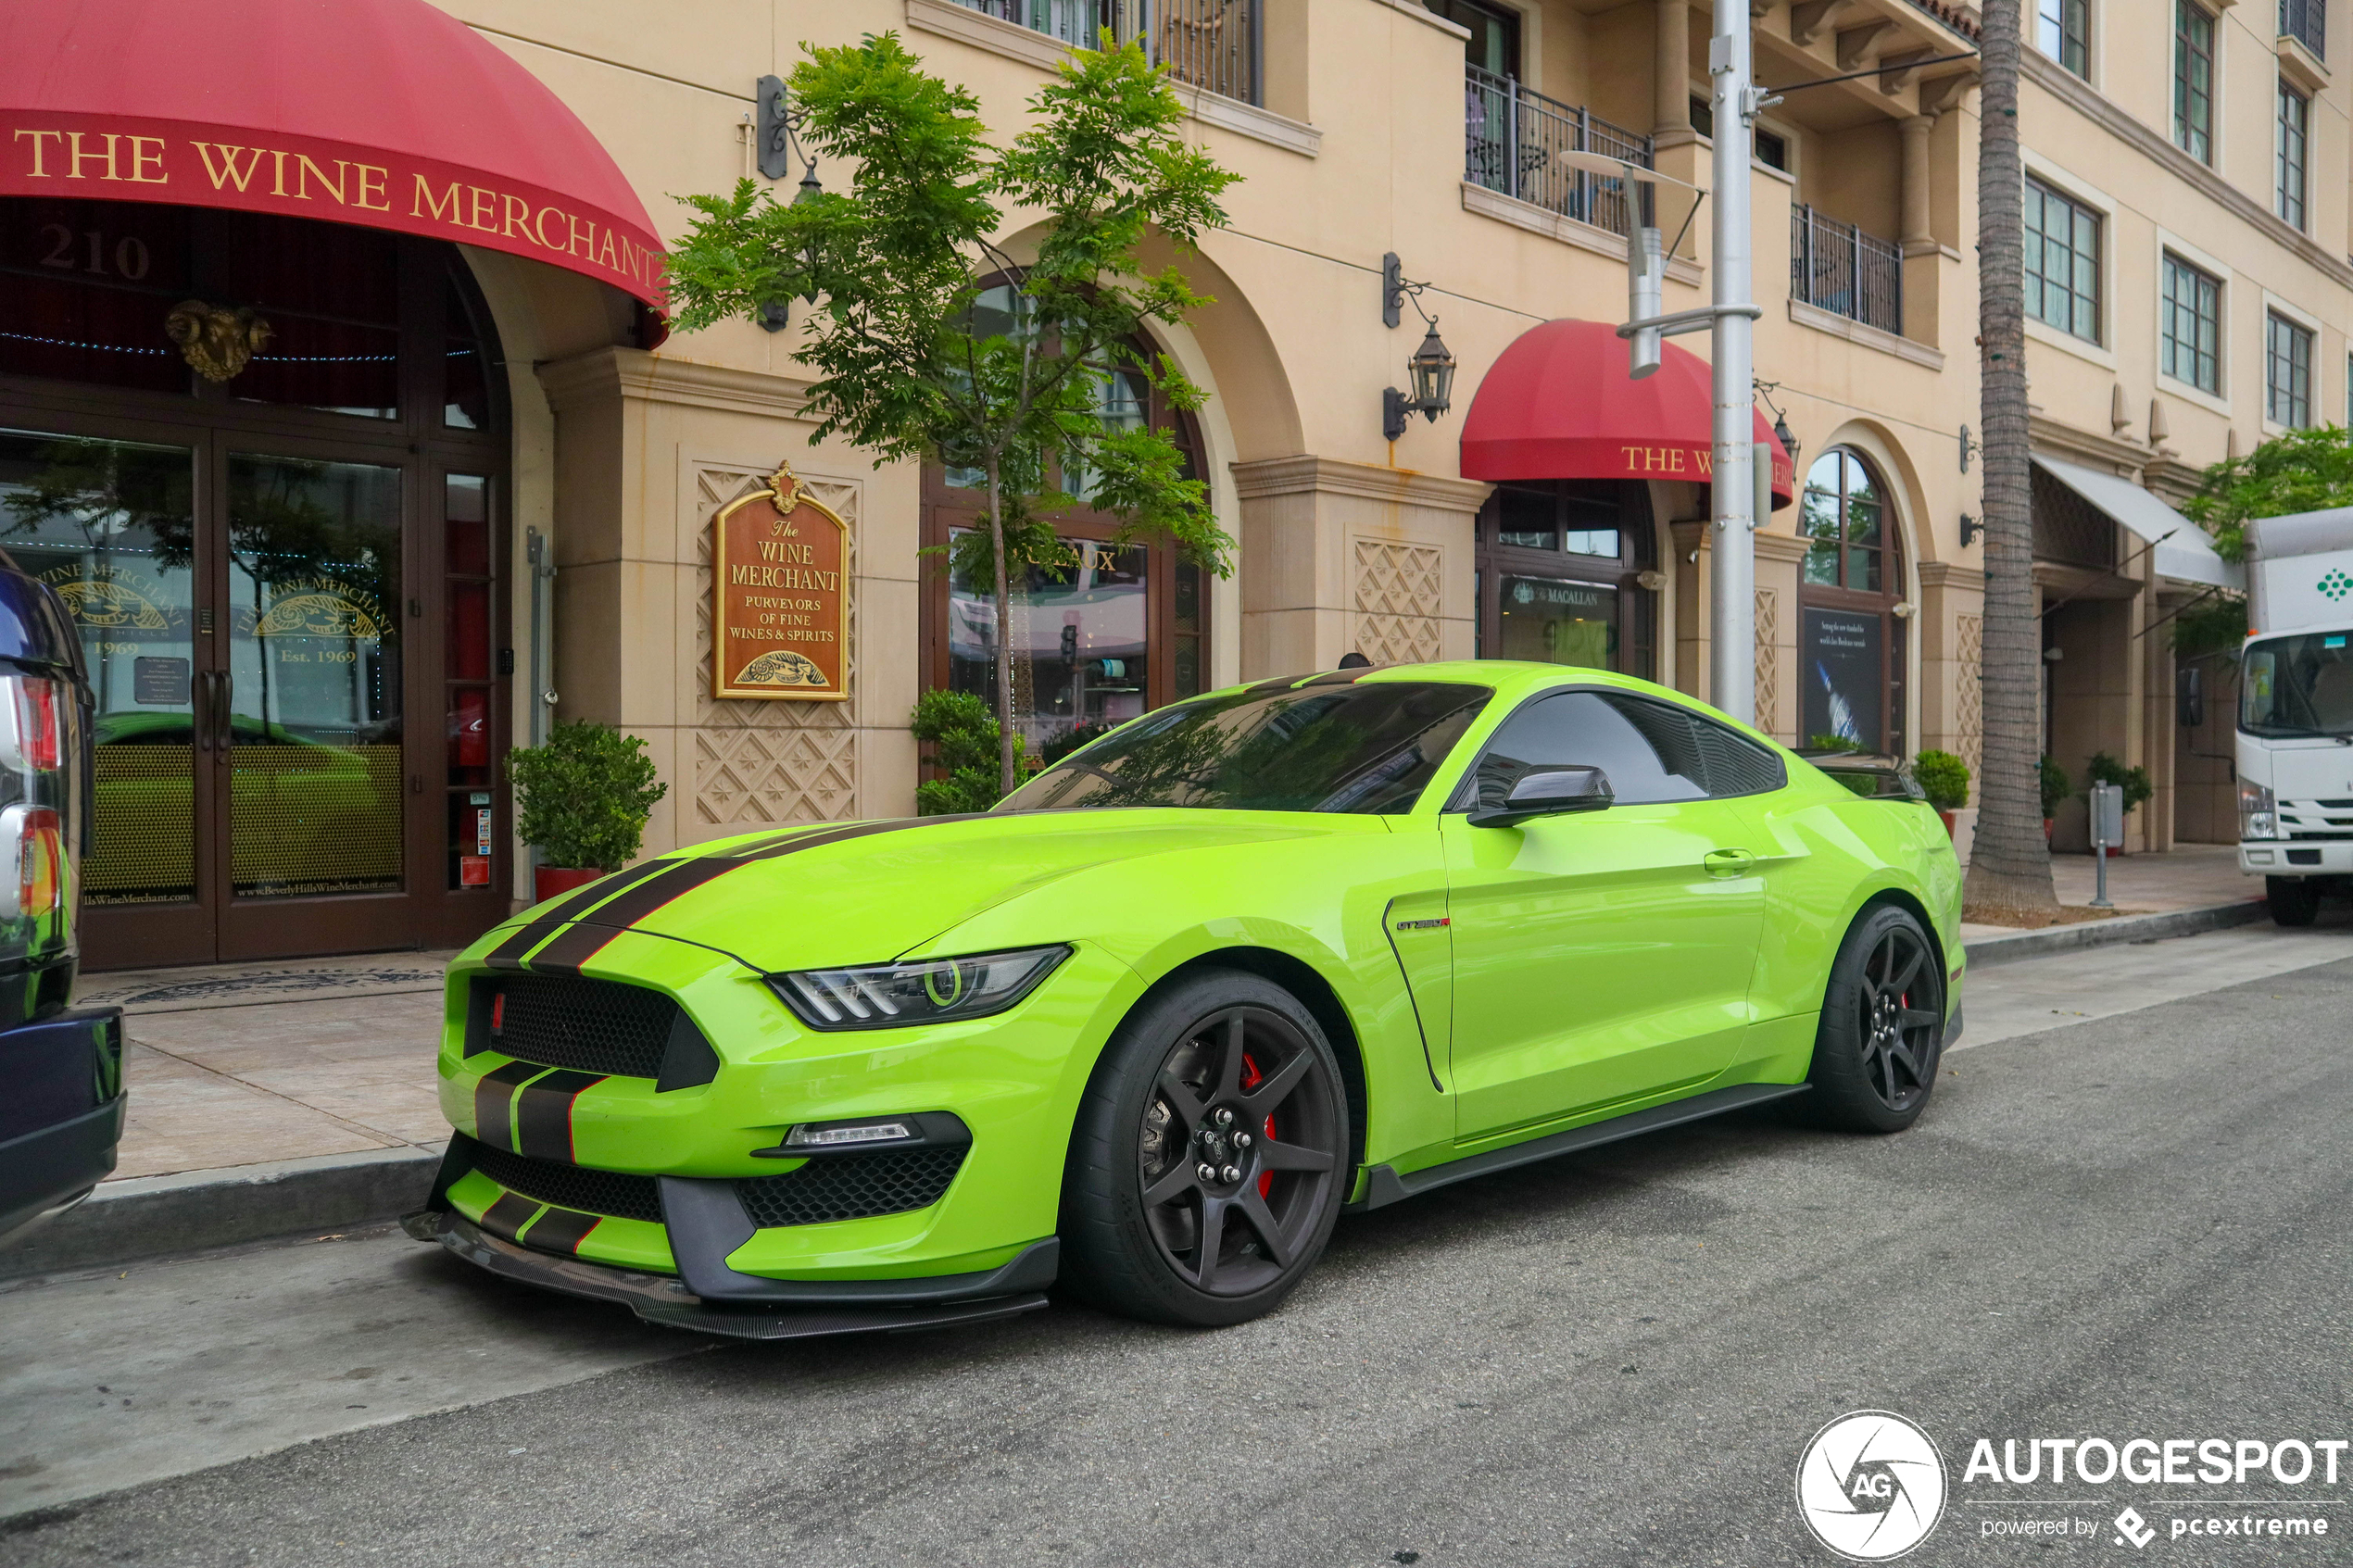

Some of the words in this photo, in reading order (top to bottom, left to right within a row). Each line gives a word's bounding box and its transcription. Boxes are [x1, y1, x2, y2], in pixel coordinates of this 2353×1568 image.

[14, 130, 169, 183] THE
[190, 140, 390, 212] WINE
[409, 173, 654, 289] MERCHANT
[39, 223, 149, 280] 210
[1622, 446, 1686, 472] THE
[771, 521, 799, 537] The
[758, 541, 813, 565] WINE
[731, 564, 838, 592] MERCHANT
[90, 563, 185, 627] MERCHANT
[745, 596, 821, 611] PURVEYORS
[1548, 588, 1598, 606] MACALLAN
[261, 577, 308, 603] WINE
[312, 577, 396, 636] MERCHANT
[760, 613, 776, 625] OF
[780, 614, 811, 626] FINE
[729, 626, 773, 640] WINES
[774, 630, 785, 640] &
[787, 631, 834, 642] SPIRITS
[94, 642, 138, 655] 1969
[282, 650, 310, 662] Est.
[318, 650, 356, 663] 1969
[238, 881, 397, 897] www.BeverlyHillsWineMerchant.com
[83, 893, 190, 906] llsWineMerchant.com
